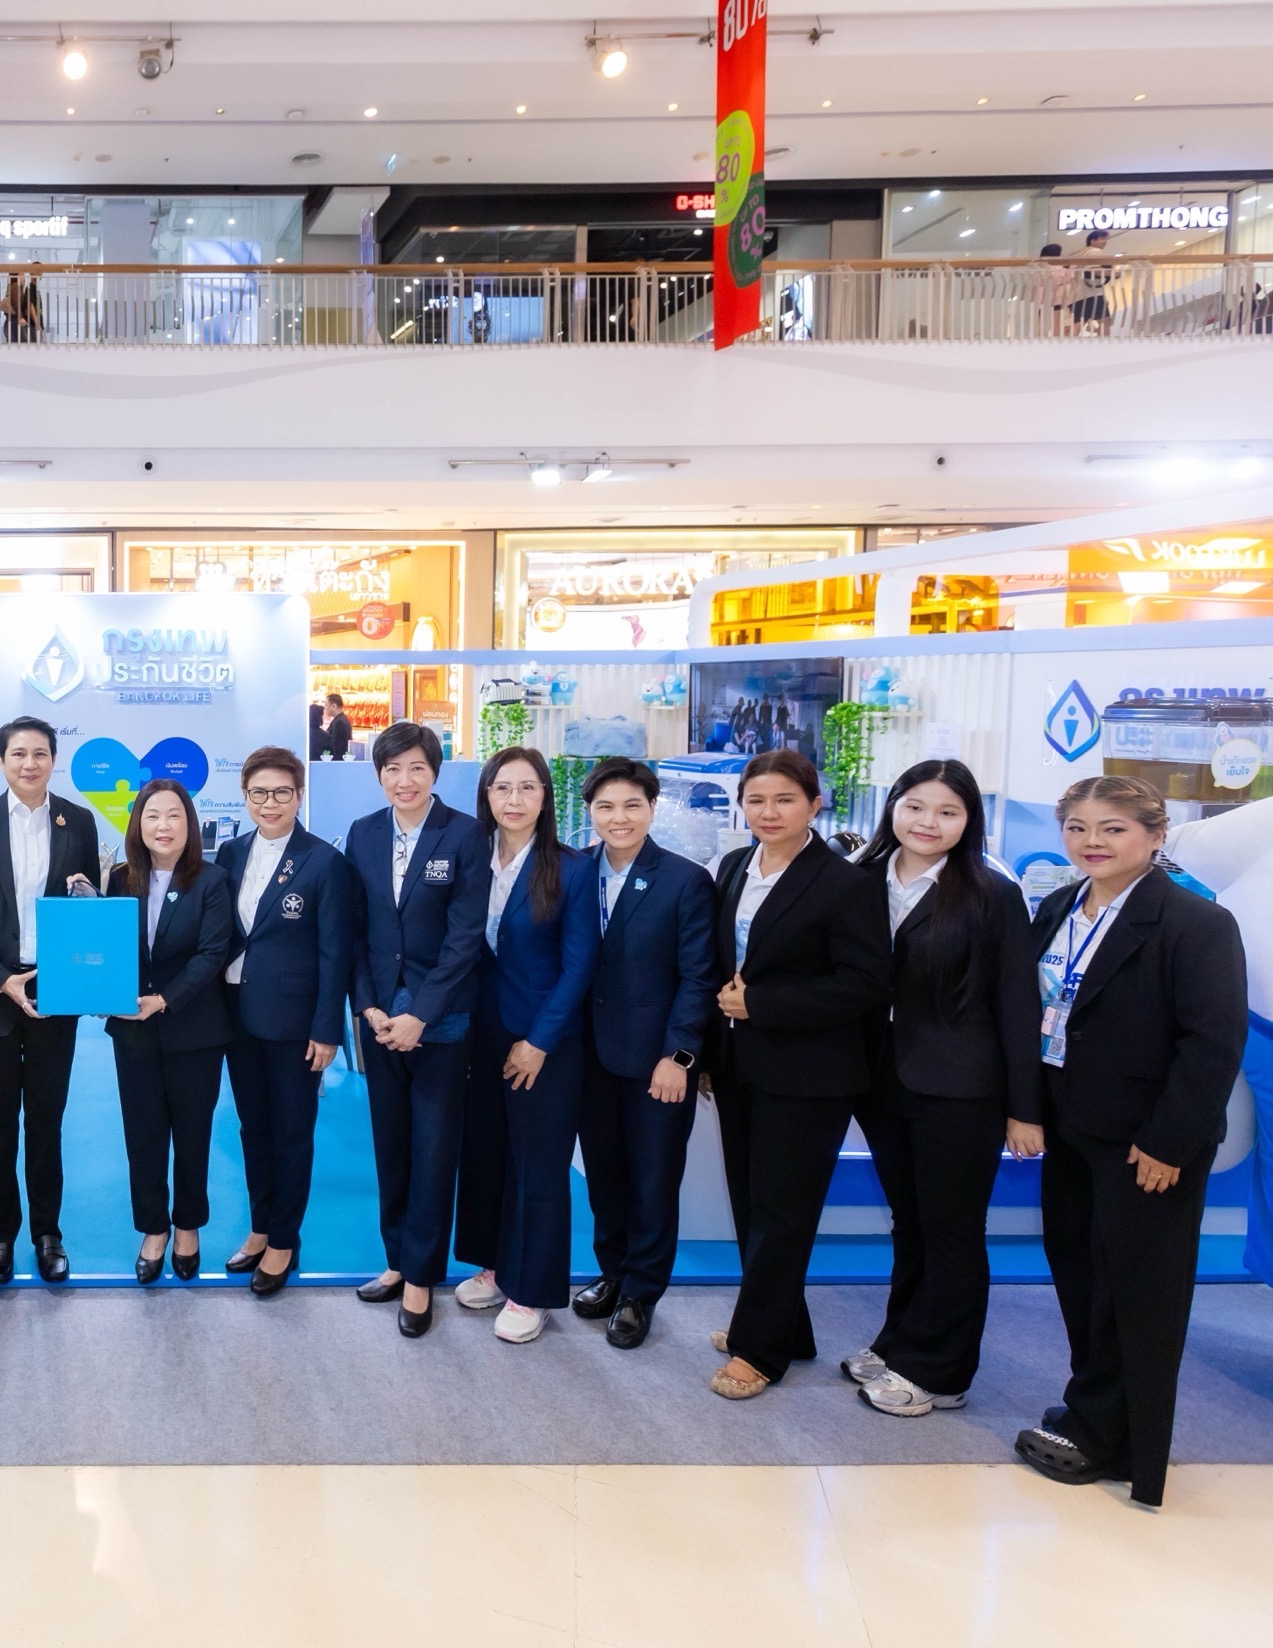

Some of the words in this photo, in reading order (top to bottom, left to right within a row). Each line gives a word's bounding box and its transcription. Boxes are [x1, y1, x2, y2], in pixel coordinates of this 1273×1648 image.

[716, 152, 740, 184] 80
[676, 194, 715, 210] G-SH
[13, 216, 69, 239] sportif
[740, 206, 765, 252] 80
[1058, 205, 1228, 230] PROMTHONG
[549, 566, 695, 595] AURORA
[102, 628, 228, 661] กรุงเทพ
[94, 656, 235, 684] ประกันชีวิต
[118, 691, 179, 702] BANGKOK
[185, 691, 213, 702] LIFE
[424, 870, 448, 878] TNQA
[1041, 953, 1065, 966] 2025
